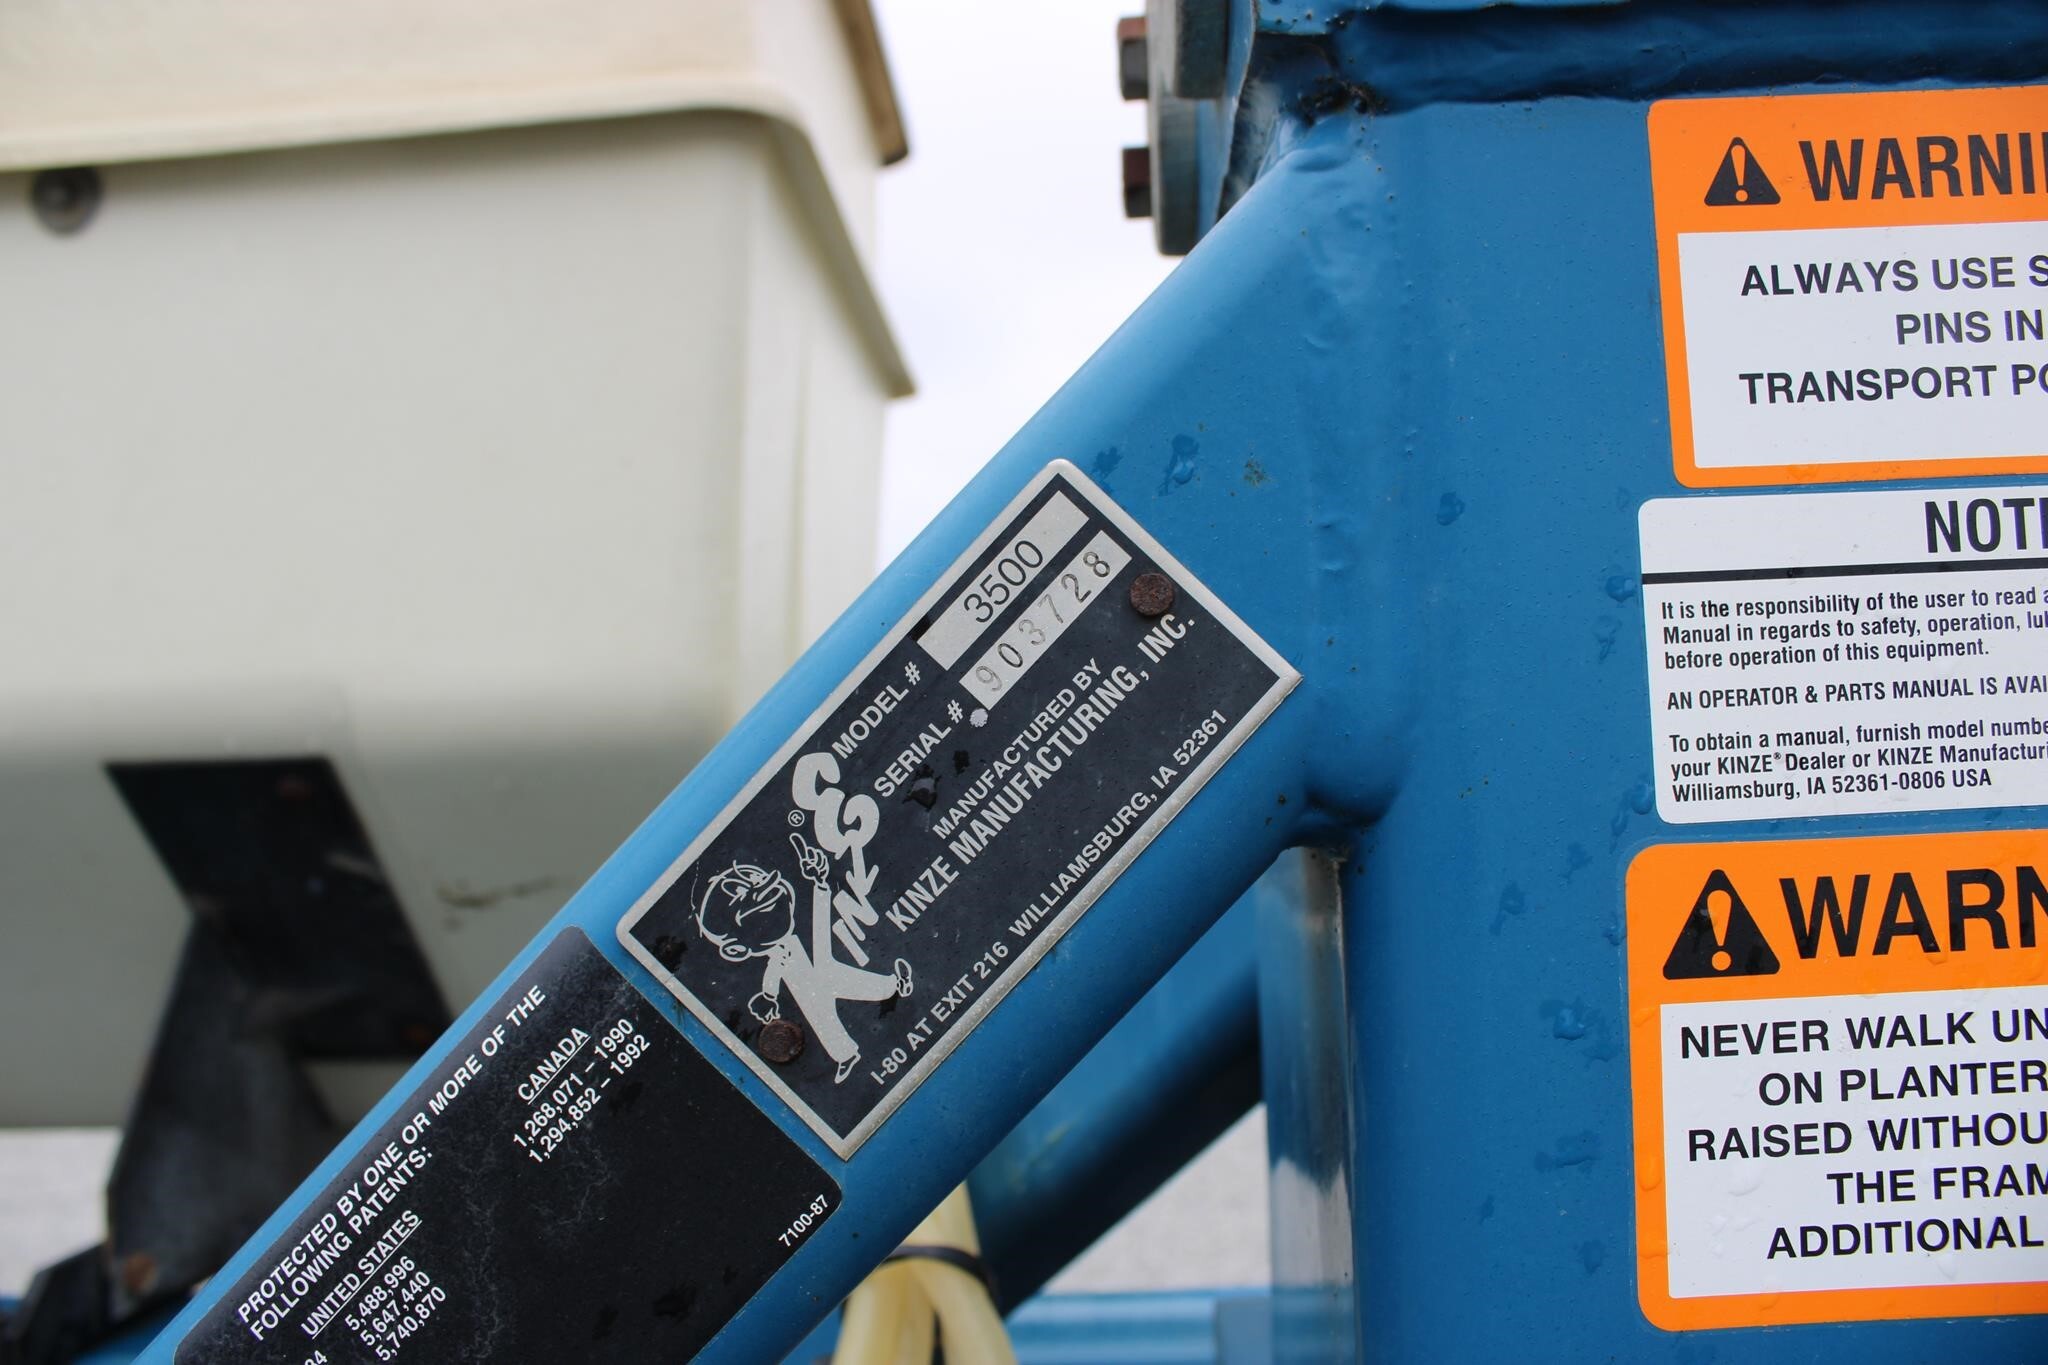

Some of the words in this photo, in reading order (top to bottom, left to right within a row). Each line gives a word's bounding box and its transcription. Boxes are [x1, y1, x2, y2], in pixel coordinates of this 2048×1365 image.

[1799, 132, 2048, 201] WARNI
[1741, 260, 1918, 296] ALWAYS
[1932, 257, 2015, 290] USE
[1896, 311, 1991, 345] PINS
[2005, 310, 2043, 341] IN
[1739, 365, 1997, 404] TRANSPORT
[1662, 602, 1674, 619] It
[1680, 601, 1694, 618] is
[1701, 600, 1729, 617] the
[1736, 595, 1859, 619] responsibility
[1867, 593, 1883, 610] of
[1890, 592, 1918, 609] the
[1925, 594, 1965, 608] user
[1972, 590, 1988, 606] to
[1996, 587, 2036, 605] read
[1664, 624, 1730, 644] Manual
[1737, 624, 1753, 641] in
[1760, 620, 1830, 643] regards
[1837, 620, 1854, 636] to
[1861, 617, 1920, 637] safety,
[1928, 614, 2020, 636] operation,
[832, 685, 909, 759] MODEL
[905, 662, 920, 685] #
[963, 540, 1043, 625] 3500
[875, 723, 951, 796] SERIAL
[948, 700, 963, 723] #
[975, 551, 1111, 692] 903728
[1665, 651, 1722, 669] before
[1730, 647, 1815, 670] operation
[1823, 644, 1839, 662] of
[1846, 643, 1879, 660] this
[1887, 639, 1988, 662] equipment.
[1668, 692, 1692, 710] AN
[1700, 687, 1798, 708] OPERATOR
[1805, 686, 1818, 703] &
[1826, 682, 1885, 702] PARTS
[1893, 679, 1973, 699] MANUAL
[1980, 677, 1997, 695] IS
[933, 689, 1075, 839] MANUFACTURED
[1073, 658, 1100, 691] BY
[1669, 735, 1689, 752] To
[1696, 732, 1752, 751] obtain
[1759, 734, 1769, 747] a
[1776, 726, 1849, 746] manual,
[1856, 723, 1920, 742] furnish
[1928, 720, 1983, 739] model
[886, 856, 959, 931] KINZE
[949, 666, 1149, 864] MANUFACTURING,
[1138, 615, 1194, 663] INC.
[1671, 762, 1711, 781] your
[1786, 752, 1845, 770] Dealer
[1853, 754, 1870, 768] or
[1878, 746, 1933, 766] KINZE
[1672, 781, 1800, 802] Williamsburg,
[1808, 777, 1826, 794] IA
[1833, 771, 1945, 793] 52361-0806
[1953, 769, 1991, 787] USA
[871, 1048, 907, 1084] I-80
[907, 1018, 932, 1050] AT
[931, 974, 974, 1021] EXIT
[974, 942, 1008, 978] 216
[1009, 793, 1157, 936] WILLIAMSBURG,
[1151, 766, 1177, 788] IA
[1173, 710, 1226, 765] 52361
[1682, 1020, 1829, 1059] NEVER
[1845, 1012, 1976, 1049] WALK
[514, 1073, 583, 1146] 1,268,071
[595, 1019, 633, 1058] 1990
[518, 1028, 590, 1102] CANADA
[1759, 1071, 1822, 1106] ON
[1840, 1060, 2048, 1101] PLANTER
[529, 1088, 601, 1162] 1,294,852
[611, 1035, 650, 1074] 1992
[238, 1213, 337, 1322] PROTECTED
[337, 1183, 362, 1216] BY
[364, 1142, 402, 1186] ONE
[402, 1112, 431, 1144] OR
[429, 1054, 482, 1115] MORE
[482, 1024, 505, 1056] OF
[506, 985, 545, 1026] THE
[1689, 1122, 1852, 1161] RAISED
[1868, 1111, 2048, 1151] WITHOU
[1827, 1169, 1915, 1204] THE
[250, 1232, 352, 1340] FOLLOWING
[349, 1147, 432, 1234] PATENTS:
[779, 1194, 828, 1247] 7100-87
[1767, 1216, 2044, 1259] ADDITIONAL
[301, 1272, 361, 1337] UNITED
[357, 1211, 422, 1277] STATES
[345, 1256, 414, 1330] 5,488,996
[360, 1272, 430, 1345] 5,647,440
[376, 1287, 445, 1360] 5,740,870
